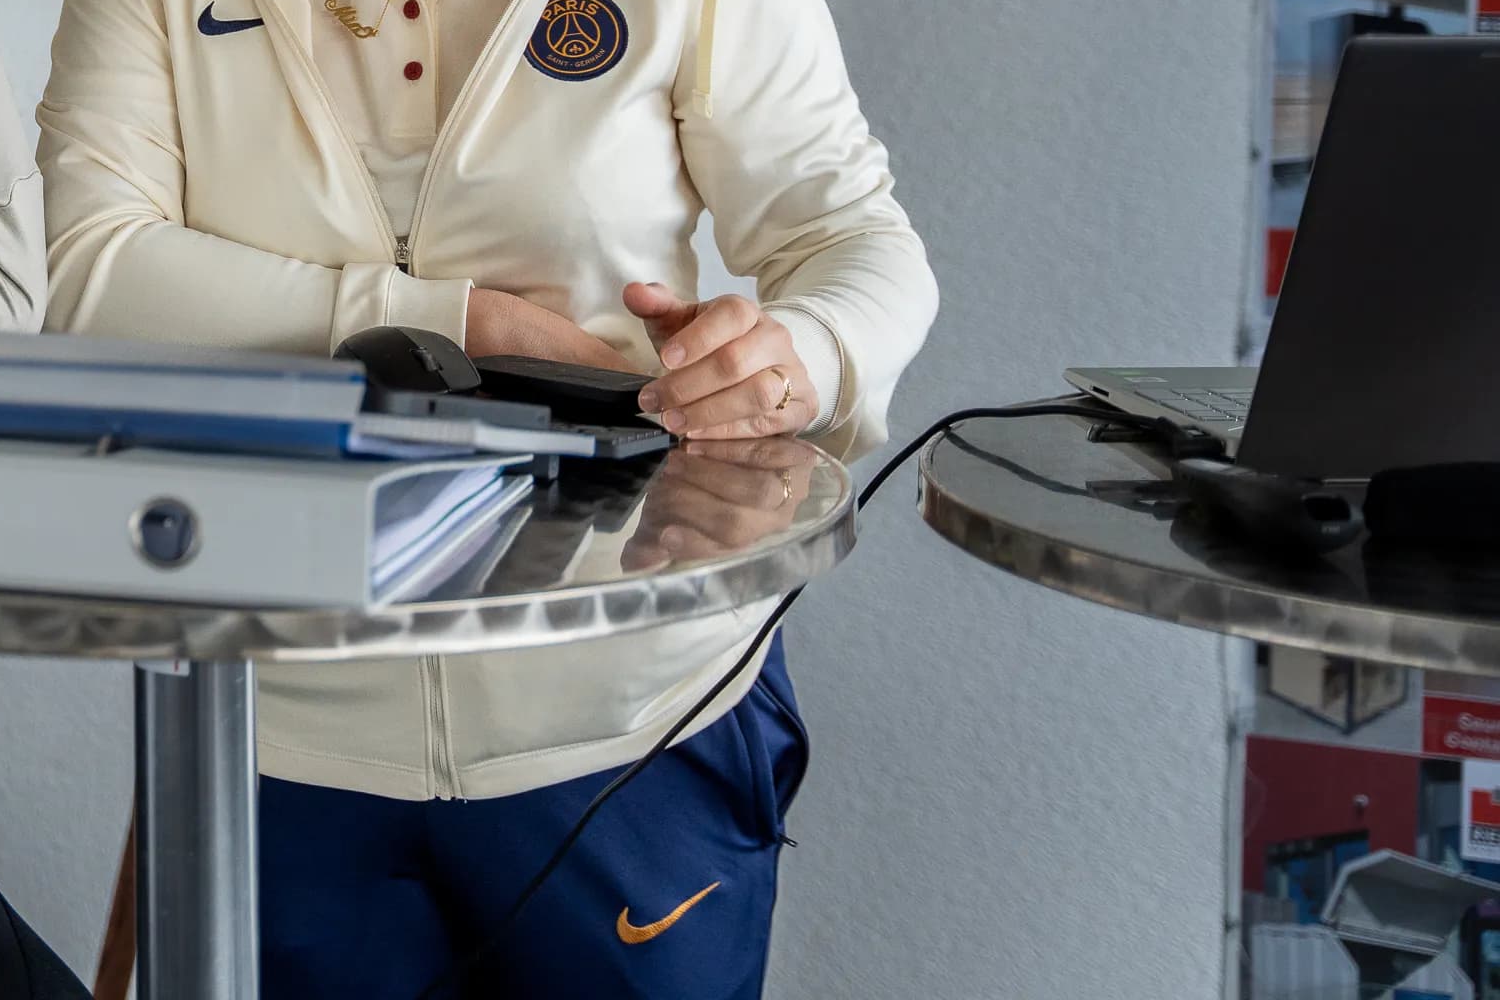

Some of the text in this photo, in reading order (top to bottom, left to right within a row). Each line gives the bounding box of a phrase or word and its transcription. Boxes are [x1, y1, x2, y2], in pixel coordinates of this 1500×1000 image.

[542, 0, 600, 22] PARIS
[546, 48, 606, 68] SAINT GERMAIN
